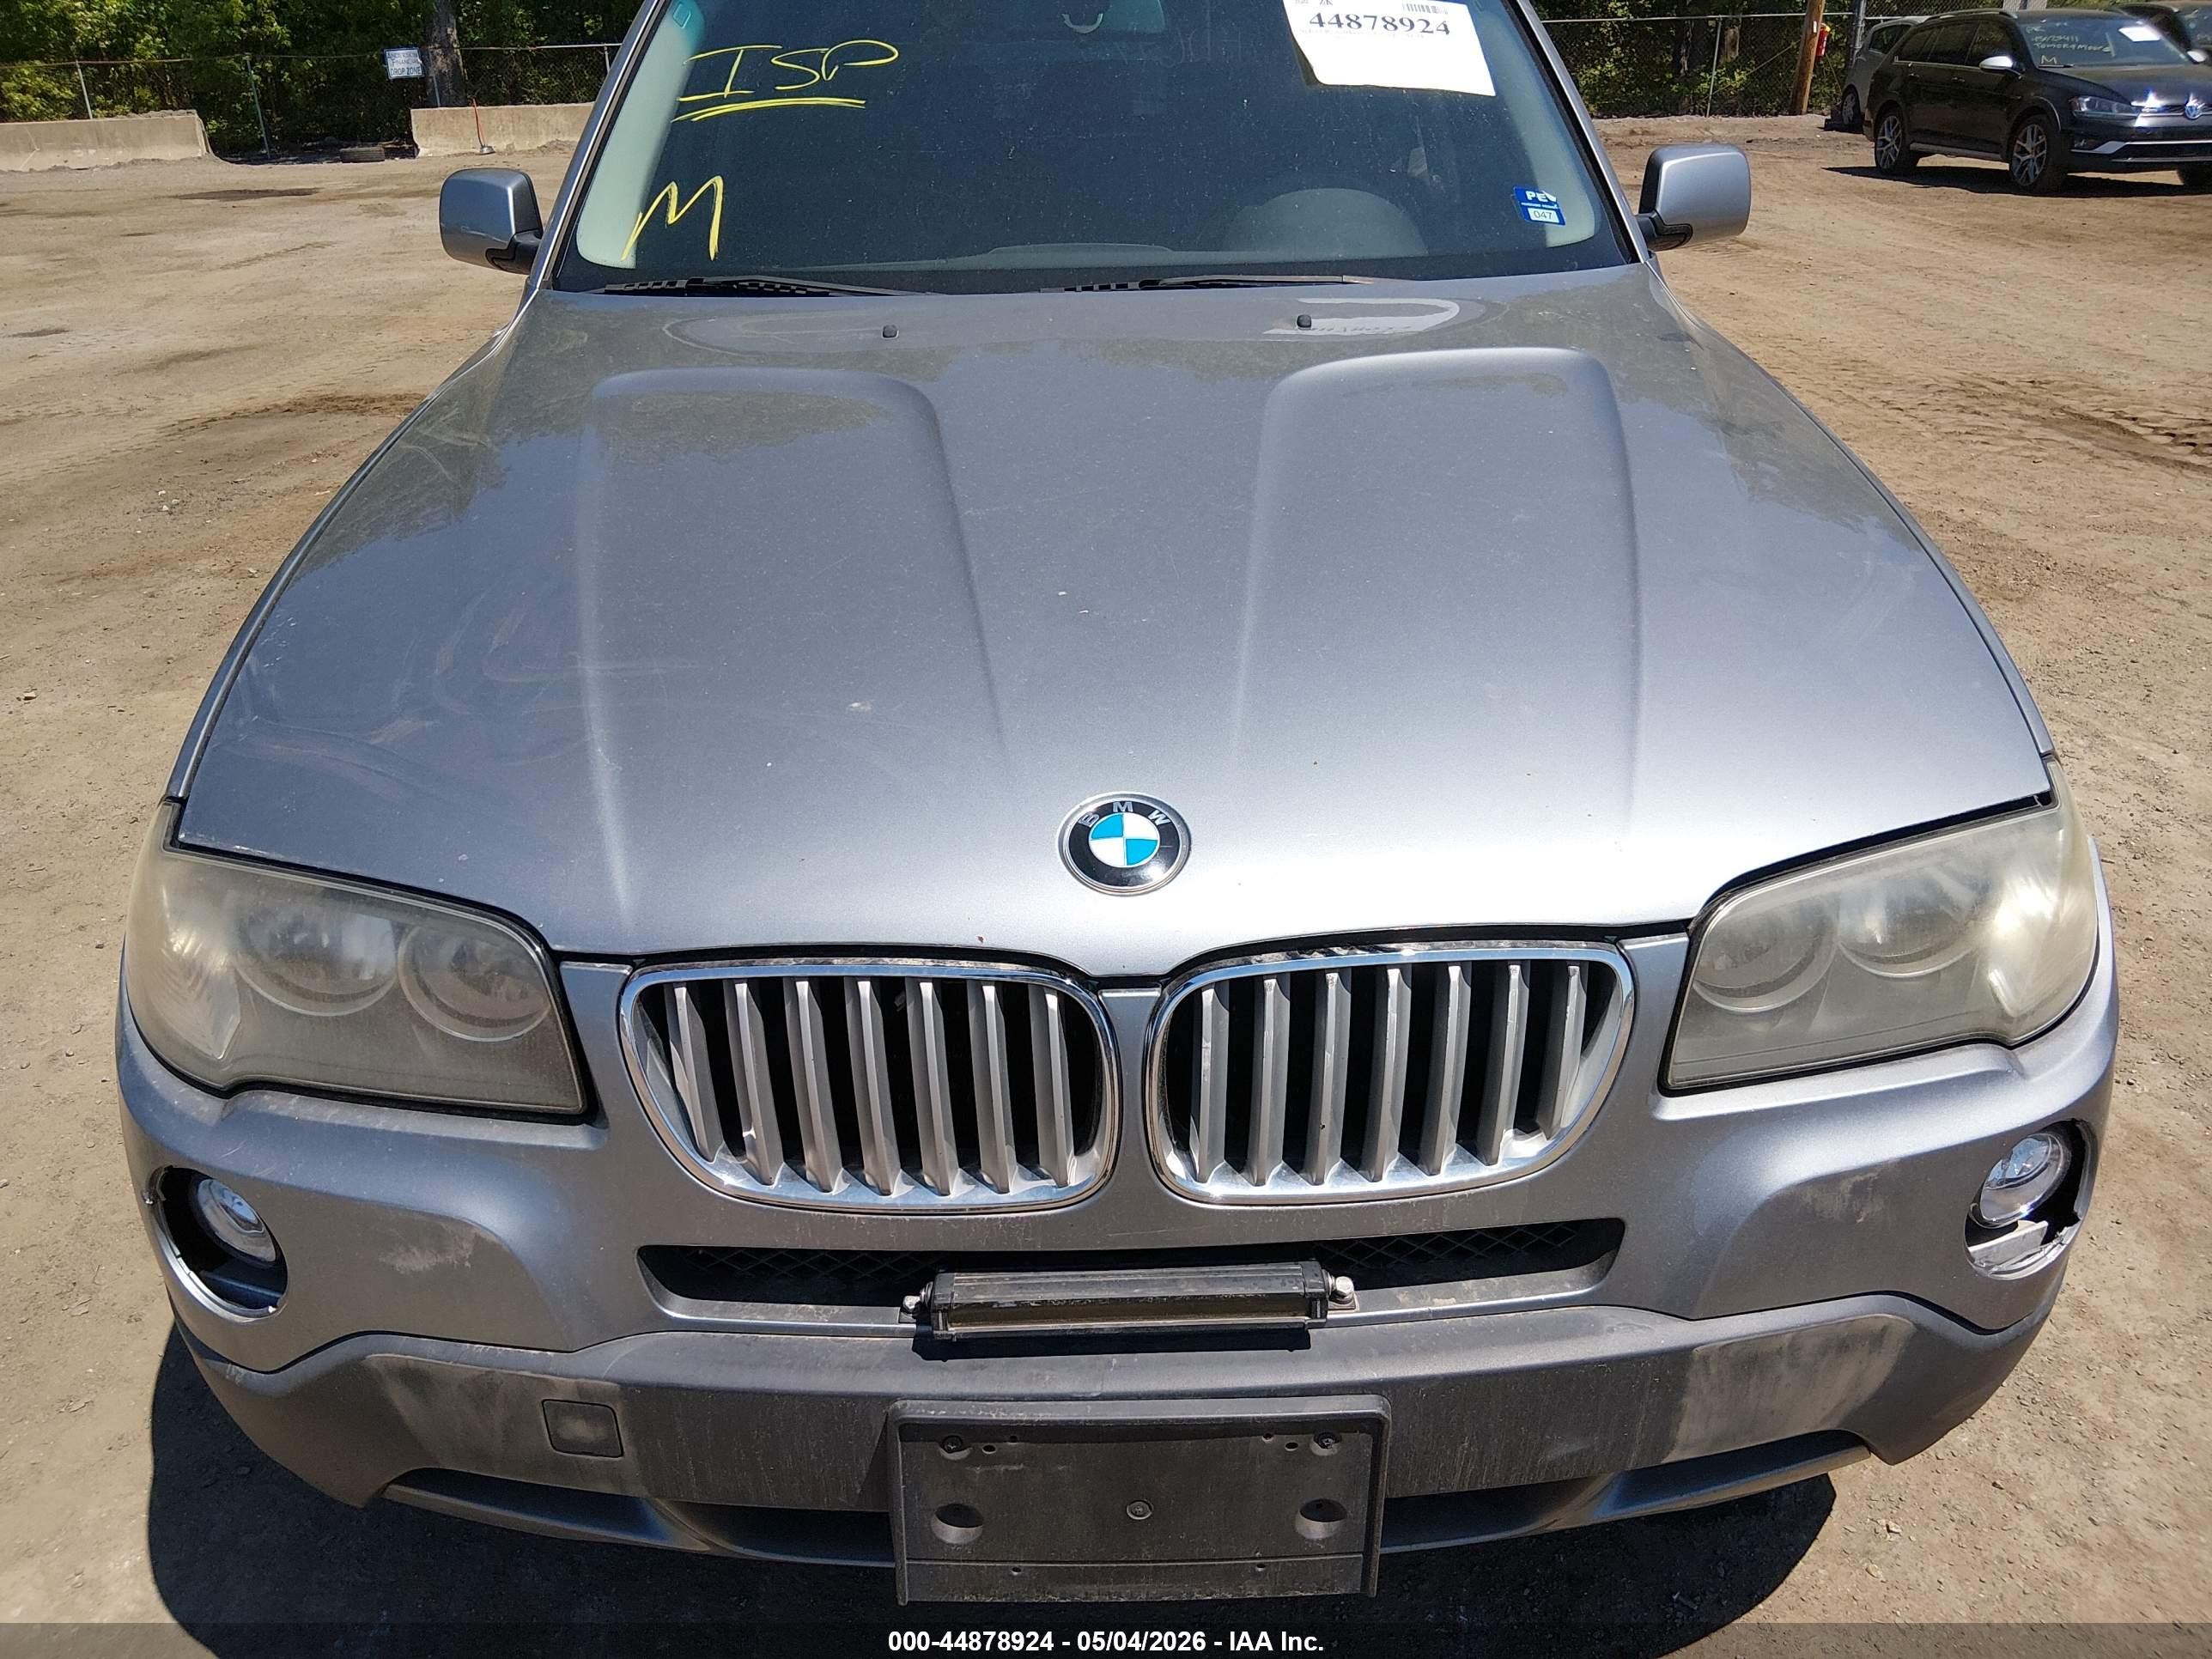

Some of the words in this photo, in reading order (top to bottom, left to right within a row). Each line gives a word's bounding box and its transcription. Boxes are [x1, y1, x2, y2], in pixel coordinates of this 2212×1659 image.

[1310, 12, 1450, 35] 44878924
[2040, 54, 2057, 64] M
[391, 67, 406, 76] DROP
[406, 65, 422, 76] ZONE
[620, 174, 724, 262] M
[1533, 210, 1553, 220] 047
[1079, 800, 1171, 828] BMW
